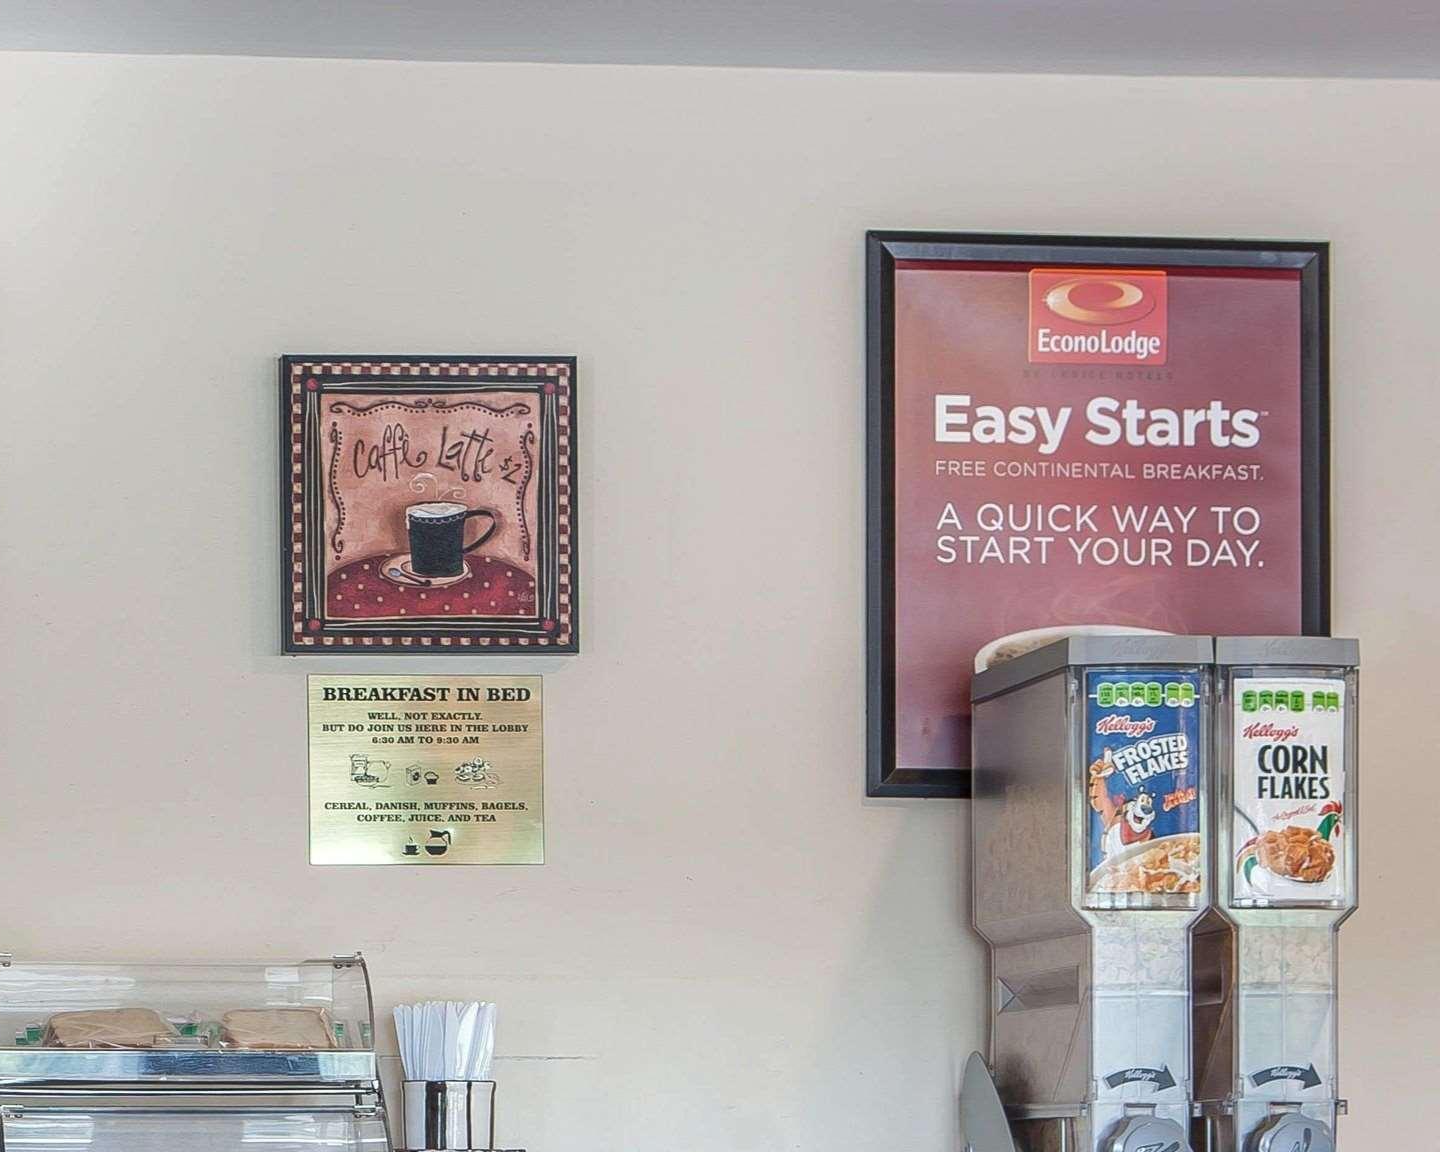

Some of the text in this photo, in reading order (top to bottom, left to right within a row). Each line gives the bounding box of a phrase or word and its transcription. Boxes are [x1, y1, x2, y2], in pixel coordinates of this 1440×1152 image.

[1037, 328, 1161, 360] EconoLodge
[935, 394, 1071, 454] Easy
[436, 426, 496, 482] Latte
[935, 460, 1265, 481] FREE CONTINENTAL BREAKFAST.
[936, 502, 1260, 535] A QUICK WAY TO
[936, 535, 1265, 568] START YOUR DAY.
[322, 687, 531, 702] BREAKFAST IN BED
[404, 712, 428, 720] NOT
[431, 712, 483, 721] EXACTLY.
[1097, 715, 1155, 737] Kellogg's
[322, 724, 529, 733] BUT DO JOIN US HERE IN THE LOBBY
[372, 736, 394, 744] 6:30
[397, 736, 415, 744] AM
[417, 736, 433, 744] TO
[462, 736, 480, 744] AM
[1242, 722, 1299, 742] Kellogg's
[1112, 735, 1187, 771] FROSTED
[1257, 744, 1328, 774] CORN
[1125, 751, 1188, 785] FLAKES
[1257, 775, 1330, 799] FLAKES
[324, 802, 372, 811] CEREAL,
[375, 802, 421, 811] DANISH,
[423, 802, 478, 811] MUFFINS,
[356, 814, 406, 823] COFFEE,
[448, 814, 471, 822] AND
[474, 814, 497, 822] TEA
